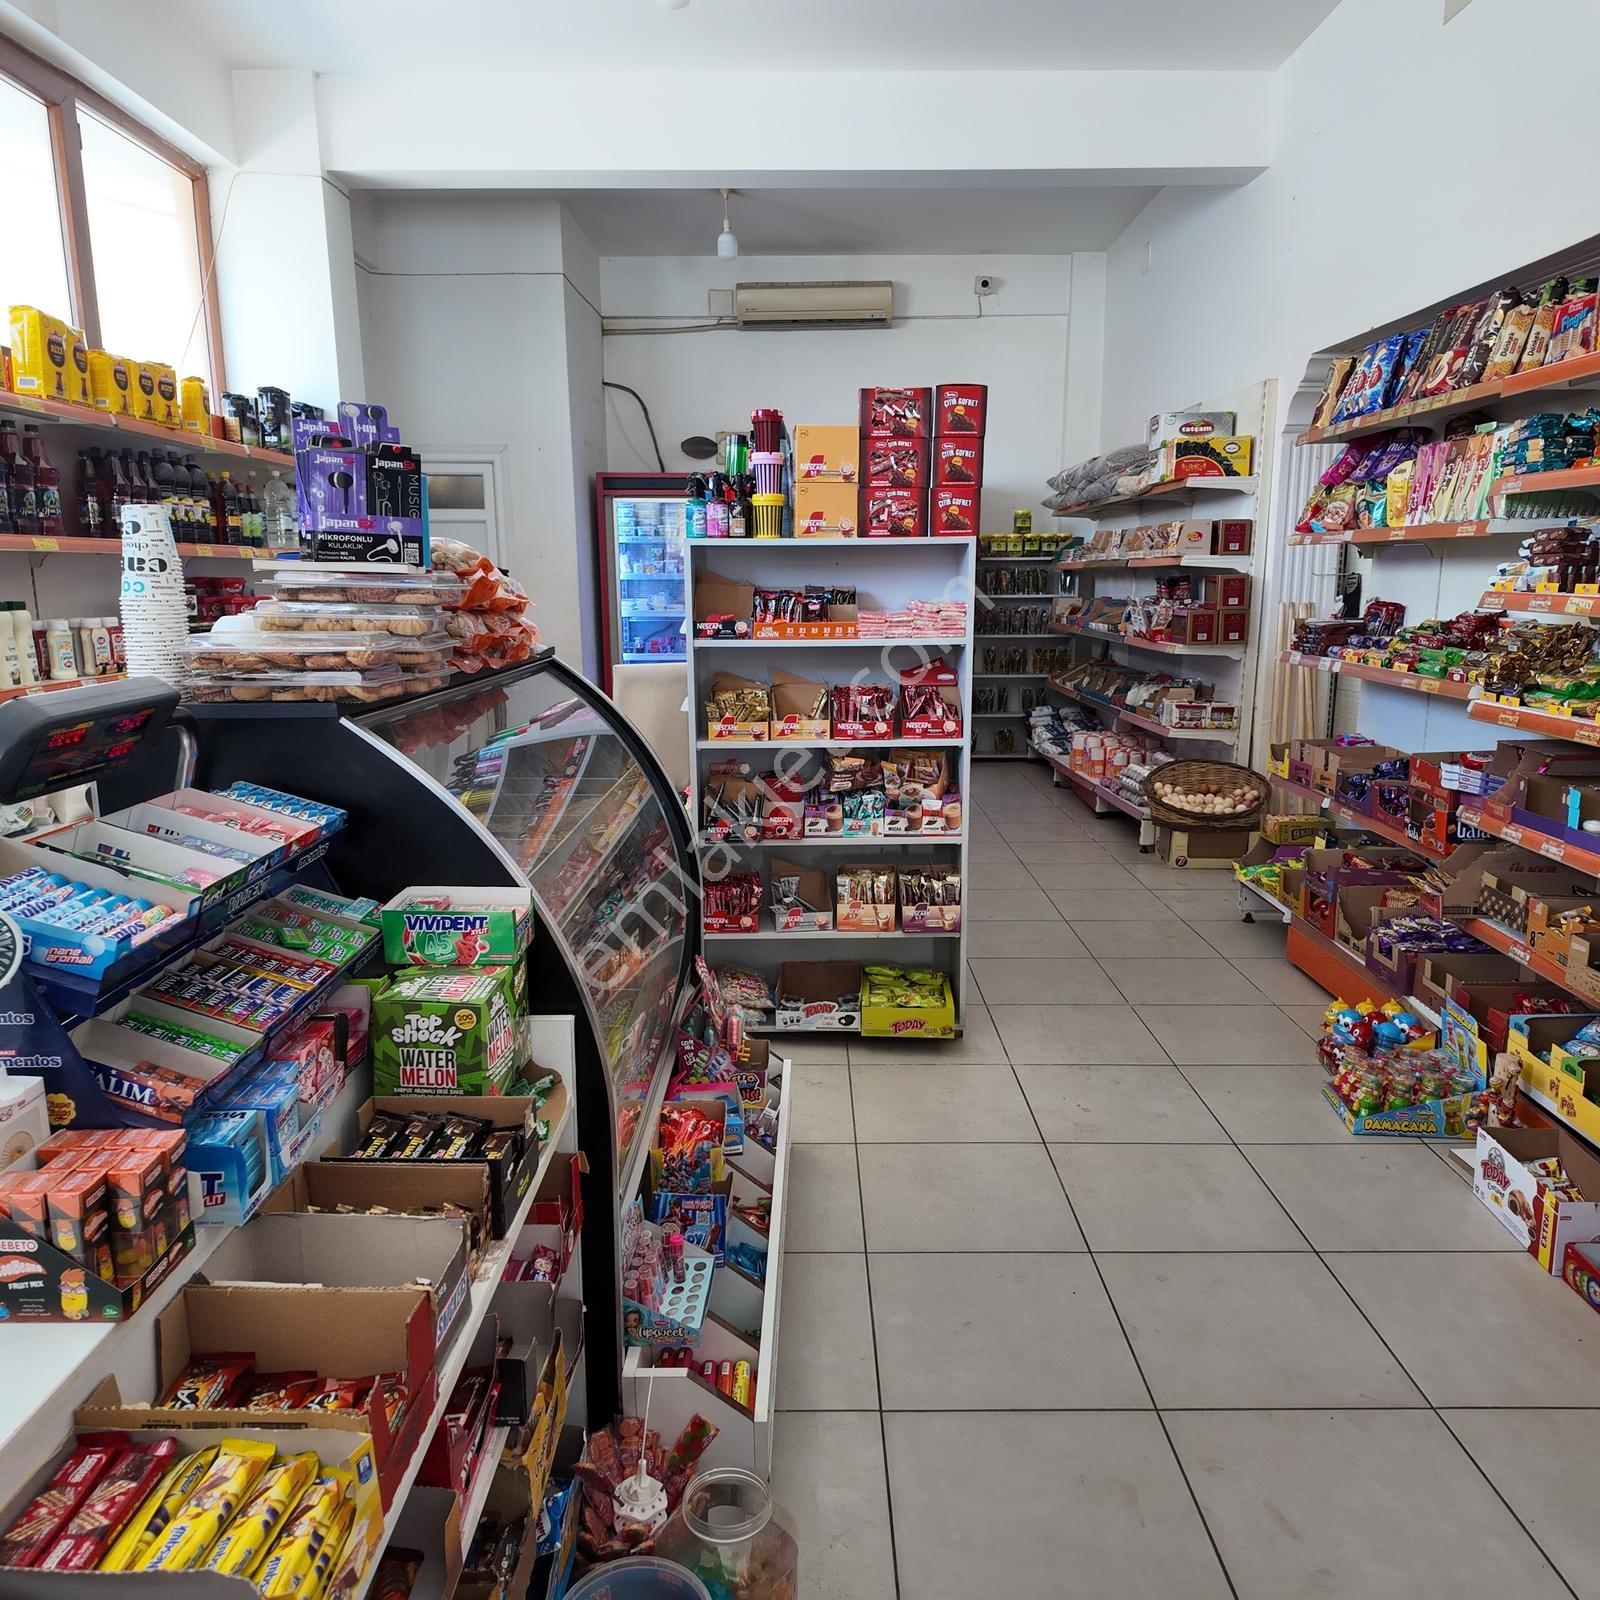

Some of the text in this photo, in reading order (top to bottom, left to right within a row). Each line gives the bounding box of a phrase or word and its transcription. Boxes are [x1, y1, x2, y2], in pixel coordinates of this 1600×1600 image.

[408, 474, 420, 519] MUSIC
[318, 532, 374, 543] MİKROFONLU
[328, 542, 364, 550] KULAKLIK
[48, 946, 82, 956] nane
[456, 1014, 474, 1022] 200
[802, 1003, 836, 1019] TODAY
[404, 1014, 442, 1031] Top
[891, 1019, 927, 1034] TODAY
[0, 1054, 62, 1068] mentos
[400, 1048, 456, 1068] WATER
[400, 1068, 456, 1088] MELON
[95, 1071, 153, 1106] ALIM
[1364, 1118, 1438, 1134] DAMACANA
[1480, 1159, 1512, 1191] TODAY
[1541, 1214, 1550, 1249] EXTRA
[0, 1240, 37, 1251] EBETO
